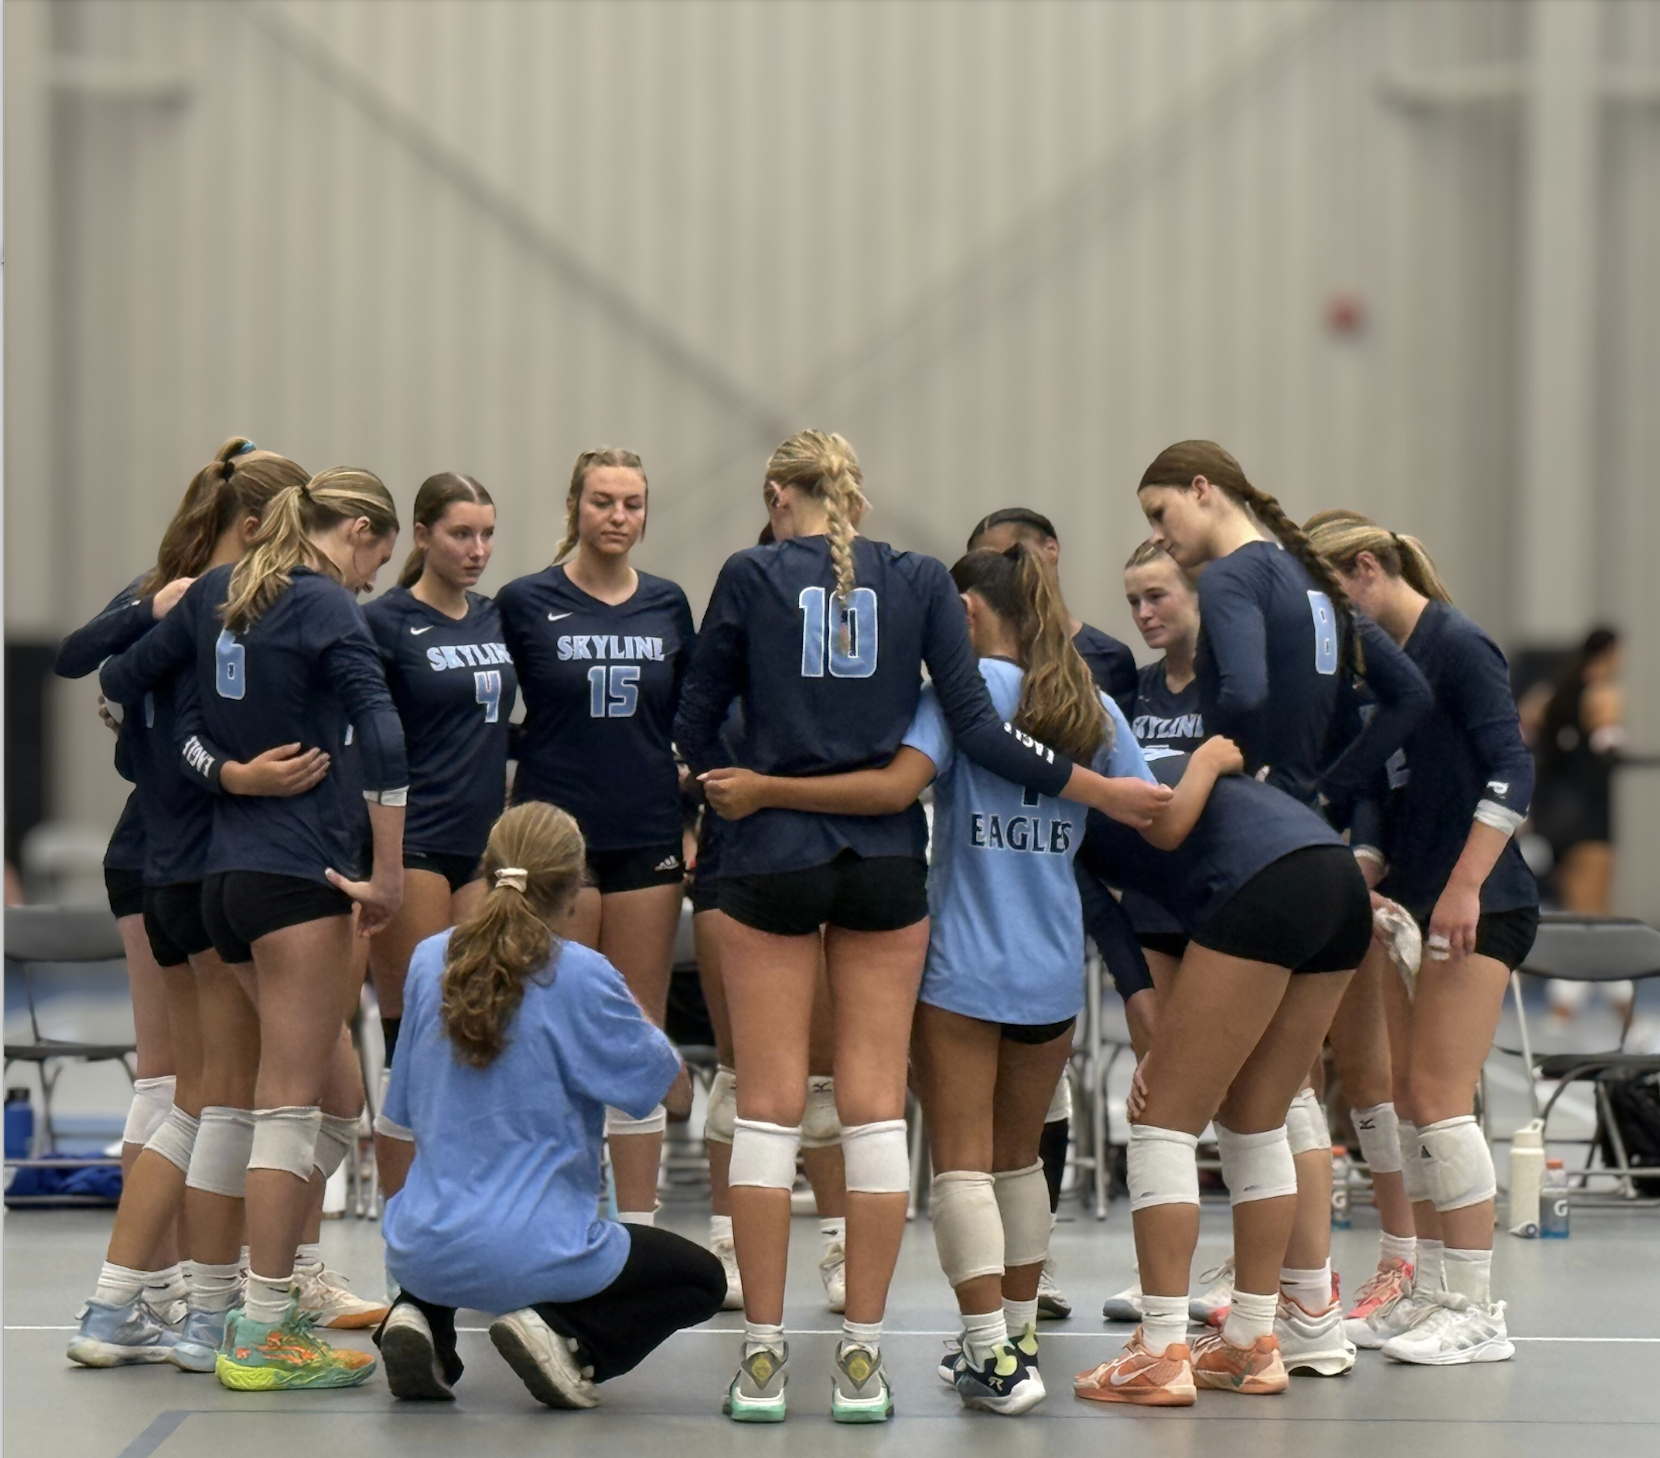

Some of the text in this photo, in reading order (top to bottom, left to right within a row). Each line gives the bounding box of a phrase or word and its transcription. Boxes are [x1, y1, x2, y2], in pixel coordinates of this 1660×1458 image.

[426, 642, 514, 672] SKYLIN
[799, 586, 878, 678] 10
[215, 624, 247, 700] 6
[473, 670, 502, 723] 4
[587, 665, 641, 718] 15
[969, 811, 1073, 856] EAGLES
[1553, 1199, 1569, 1218] G
